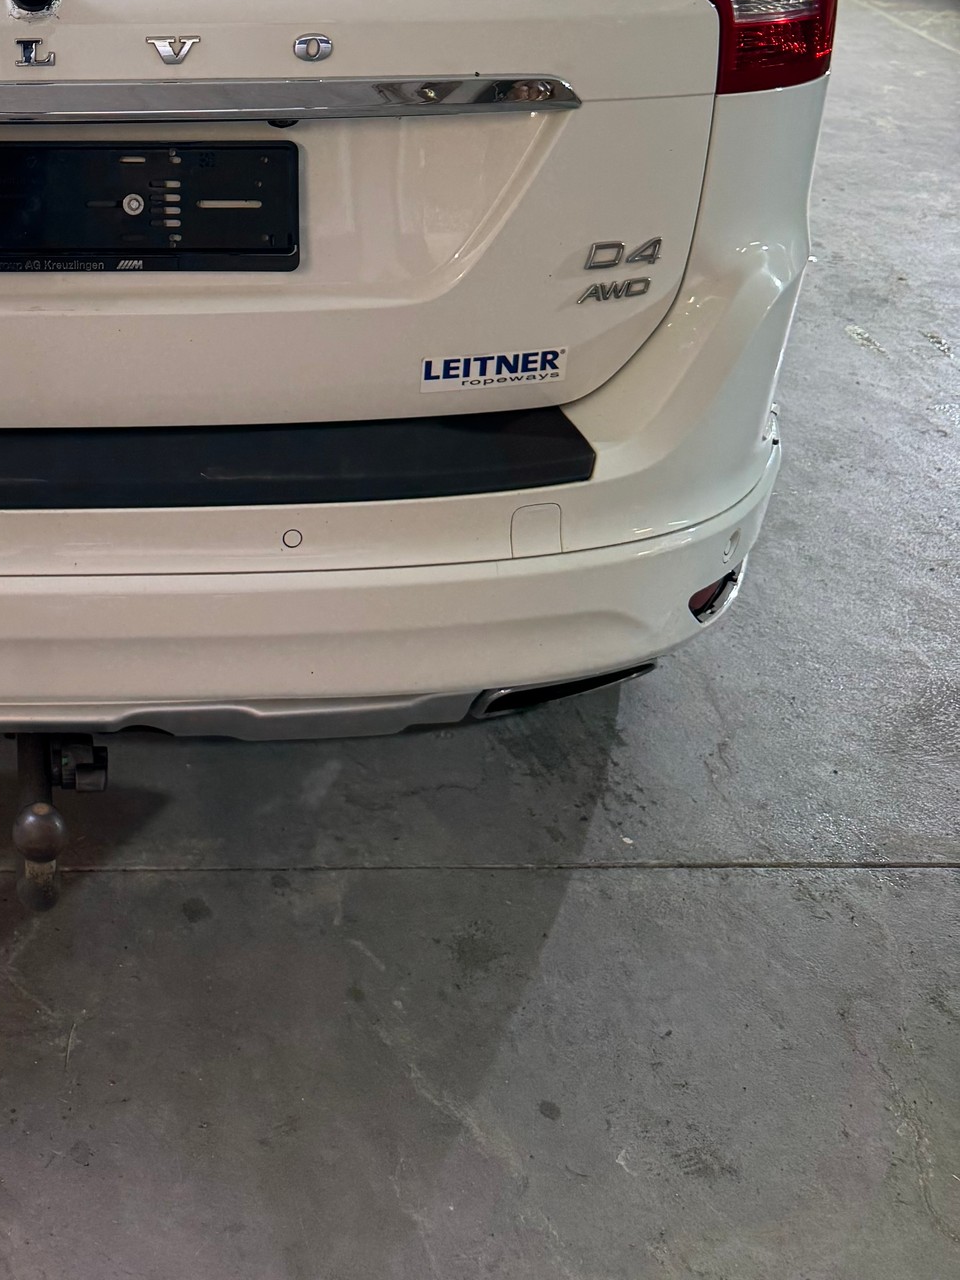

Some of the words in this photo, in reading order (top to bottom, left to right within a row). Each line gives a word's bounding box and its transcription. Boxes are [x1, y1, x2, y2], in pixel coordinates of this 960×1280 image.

[584, 236, 663, 270] D4
[25, 260, 41, 270] AG
[44, 259, 105, 271] Kreuzlingen
[577, 276, 652, 304] AWD
[461, 371, 560, 386] ropeways
